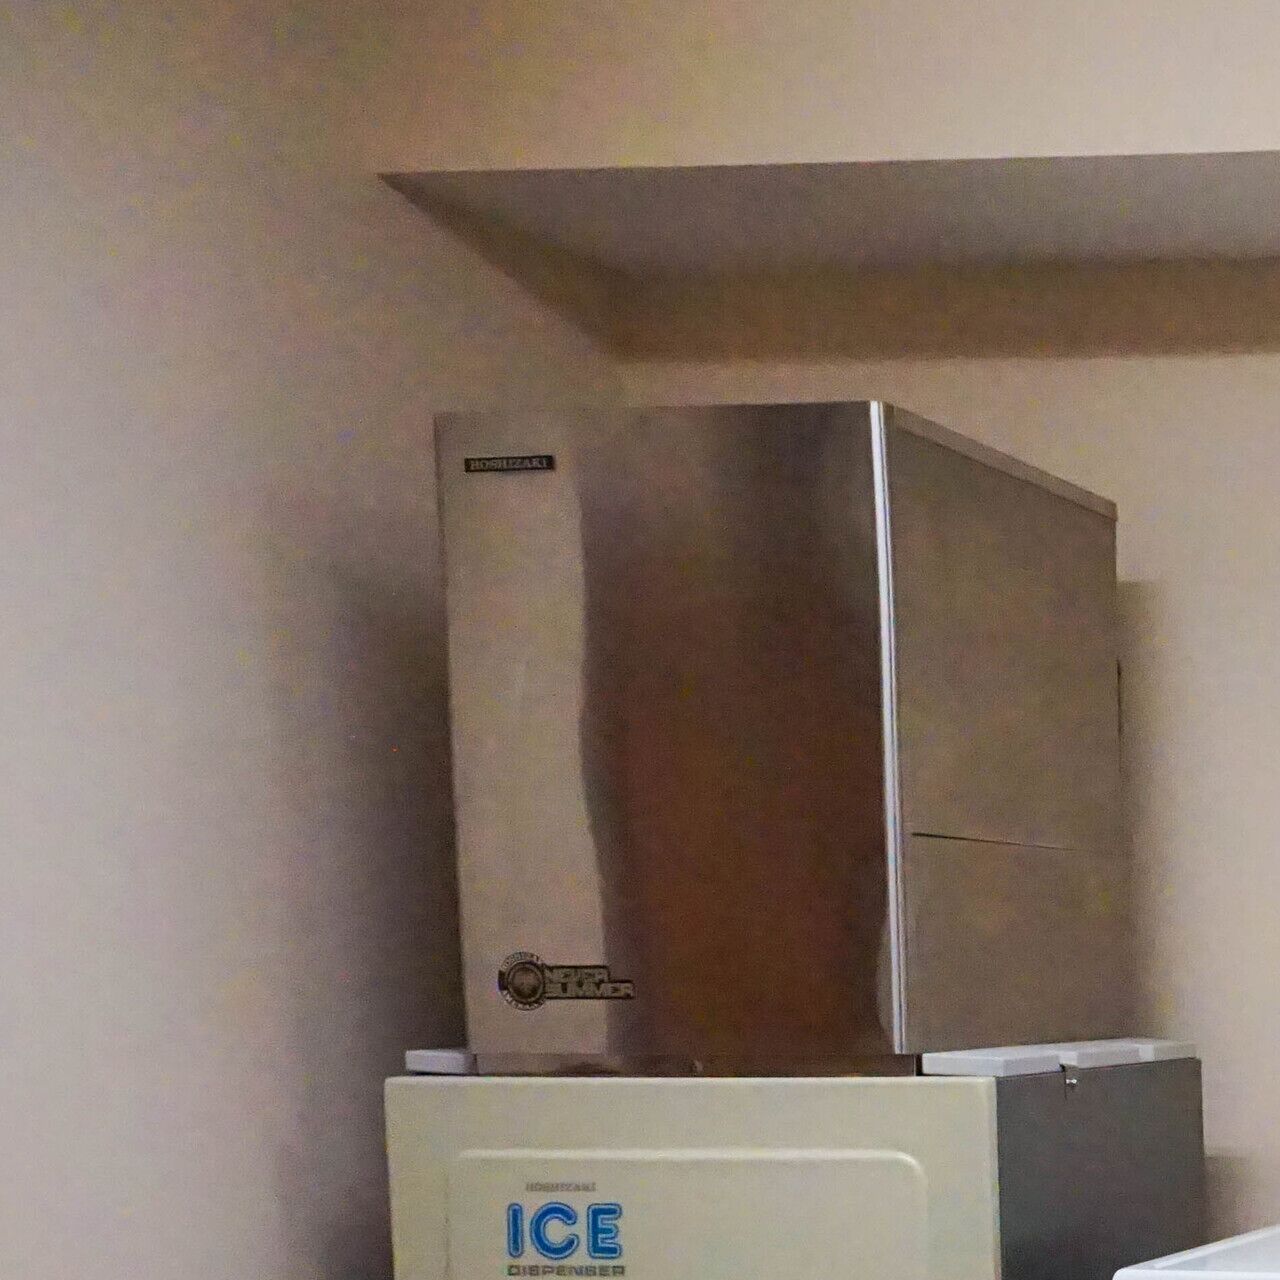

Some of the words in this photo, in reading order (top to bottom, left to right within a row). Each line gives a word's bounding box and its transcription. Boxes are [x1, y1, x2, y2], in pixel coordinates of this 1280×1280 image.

[469, 457, 550, 471] HOSHIZAKI
[544, 982, 635, 999] SUMMER
[507, 1201, 623, 1260] ICE
[507, 1264, 626, 1276] DISPENSER
